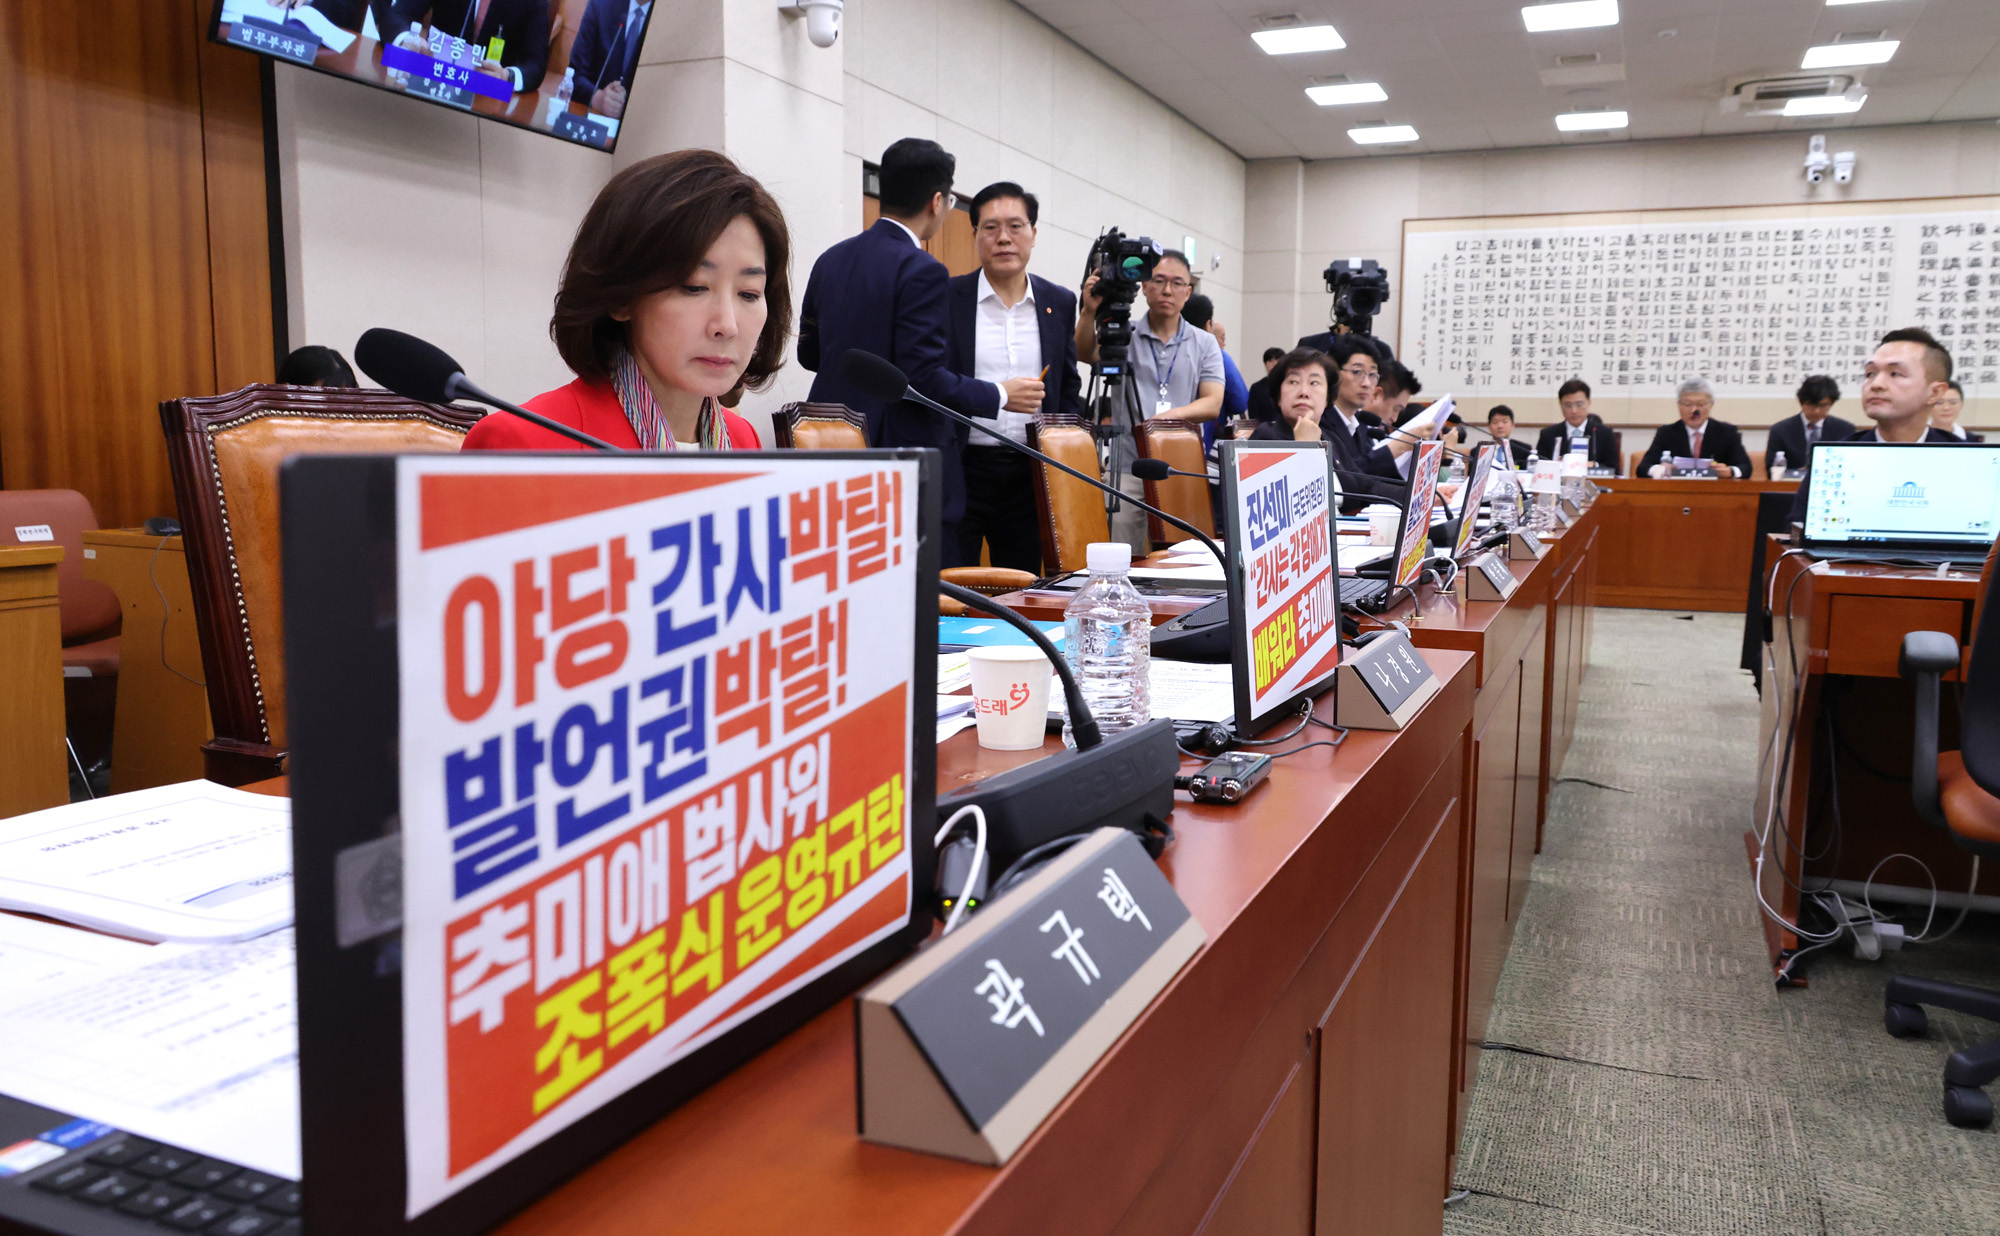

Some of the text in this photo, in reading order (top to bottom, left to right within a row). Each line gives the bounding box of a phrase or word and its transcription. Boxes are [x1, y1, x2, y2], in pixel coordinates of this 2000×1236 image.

[428, 29, 487, 68] 김종민
[433, 62, 470, 86] 변호사
[443, 535, 636, 724] 야당
[1253, 604, 1297, 693] 배워라
[1297, 572, 1334, 648] 추미애
[450, 818, 670, 1034] 추미애
[683, 732, 830, 905] 법사위
[532, 890, 725, 1116] 조폭식
[734, 773, 905, 970] 운영규탄
